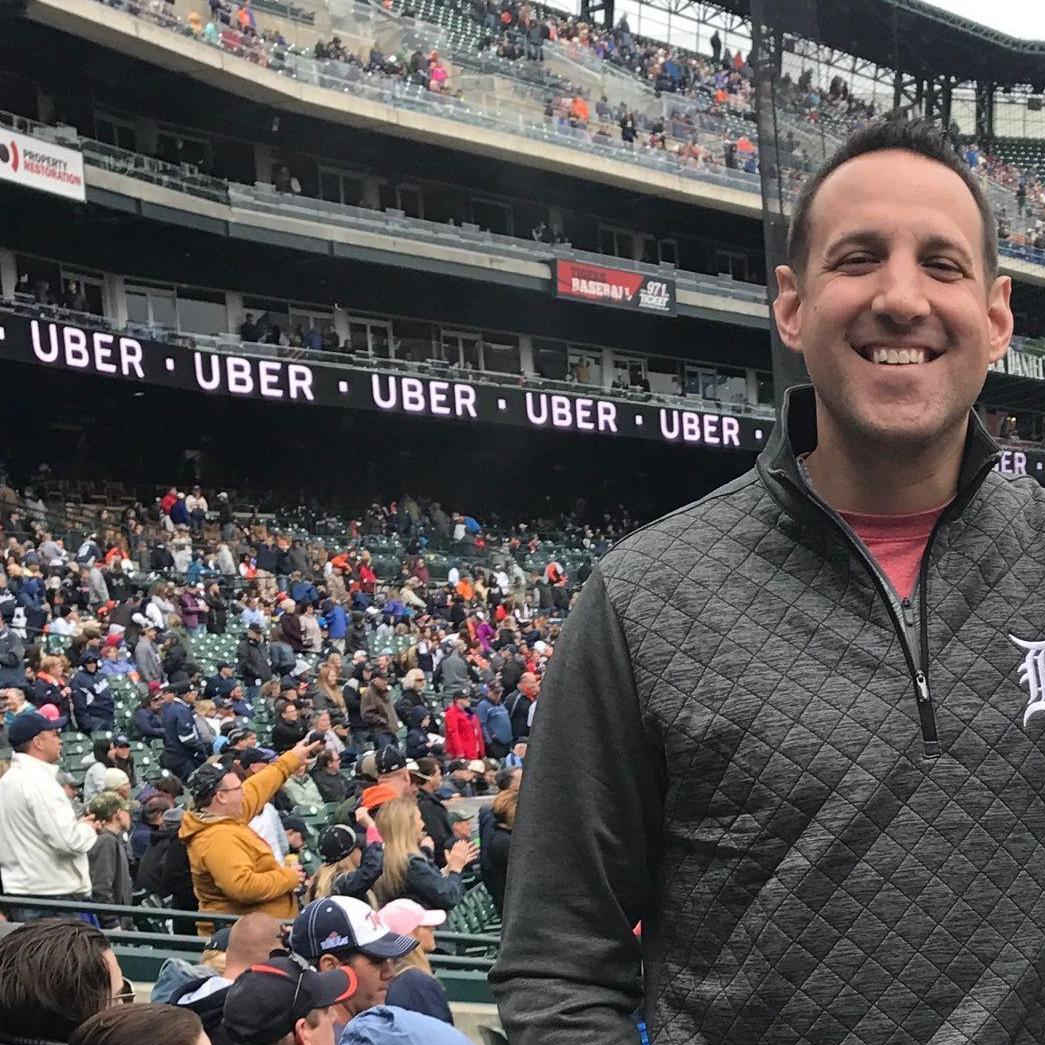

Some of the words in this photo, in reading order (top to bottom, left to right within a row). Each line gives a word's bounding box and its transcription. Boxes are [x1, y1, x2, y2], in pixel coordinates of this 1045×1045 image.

[31, 320, 145, 378] UBER
[194, 352, 315, 401] UBER
[371, 374, 477, 417] UBER
[525, 392, 618, 433] UBER
[660, 408, 741, 447] UBER
[1000, 451, 1027, 475] ER
